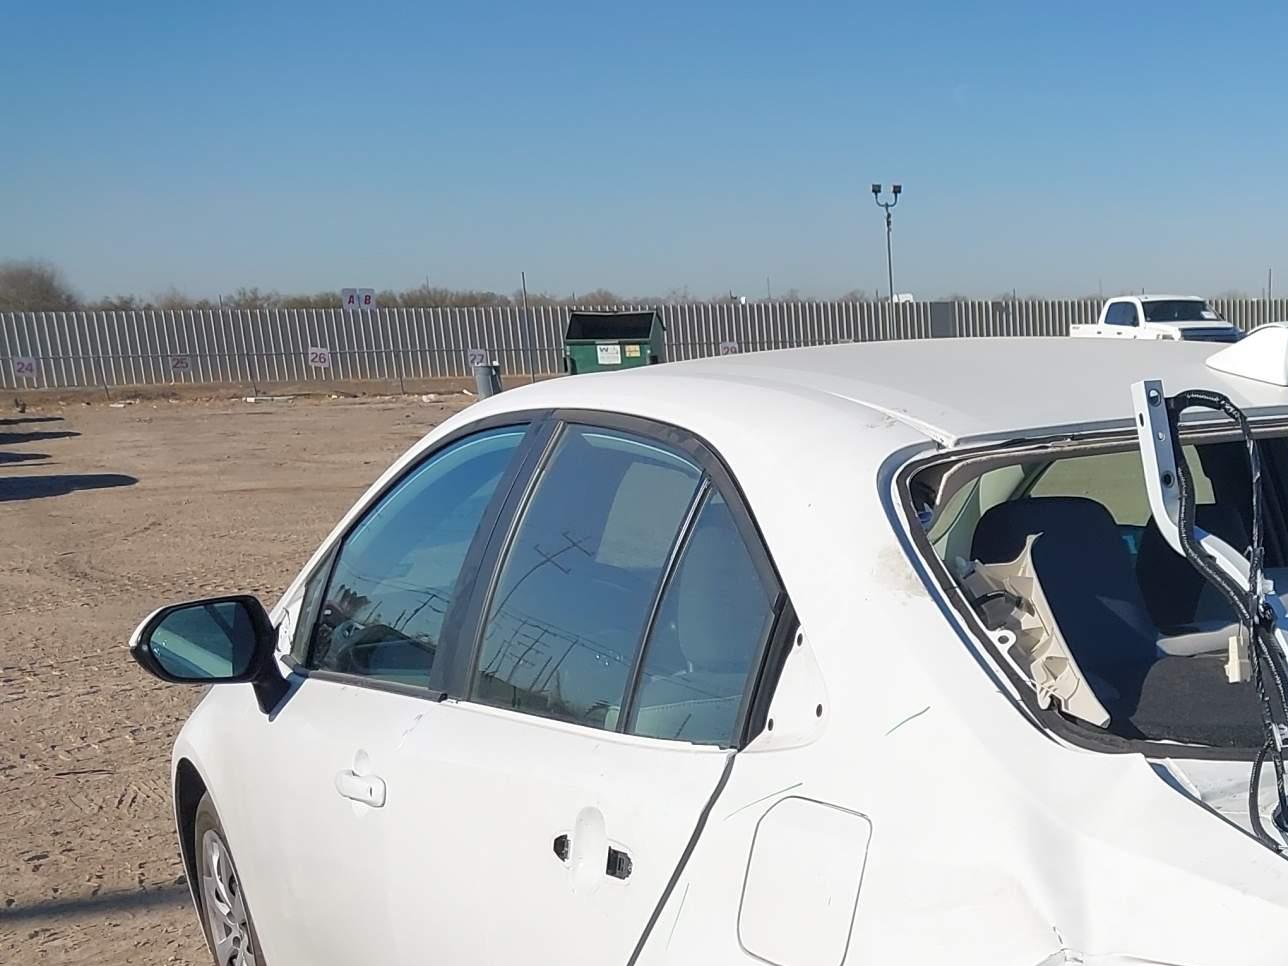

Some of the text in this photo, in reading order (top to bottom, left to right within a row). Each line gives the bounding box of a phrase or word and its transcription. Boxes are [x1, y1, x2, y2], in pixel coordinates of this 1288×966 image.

[364, 295, 371, 304] B
[311, 352, 326, 363] 26
[470, 353, 484, 365] 27
[16, 361, 33, 373] 24
[173, 358, 188, 369] 25
